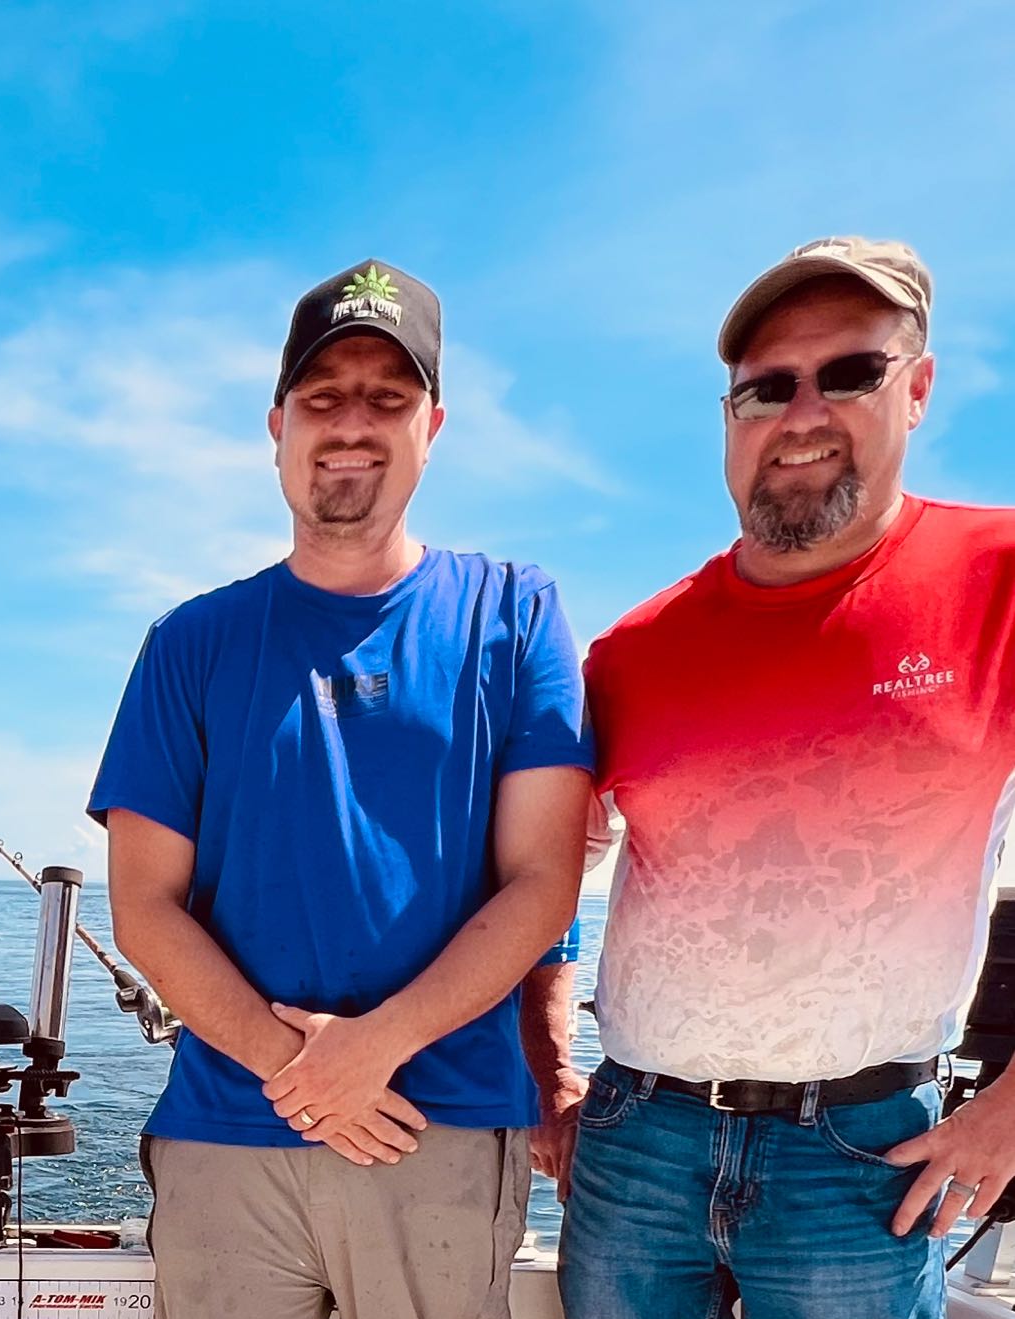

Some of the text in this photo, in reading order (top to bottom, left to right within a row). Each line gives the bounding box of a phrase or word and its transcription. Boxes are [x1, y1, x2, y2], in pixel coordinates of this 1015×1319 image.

[331, 295, 402, 326] NEW YORK
[872, 670, 955, 695] REALTREE
[31, 1294, 106, 1303] A-TOM-MIK
[113, 1297, 127, 1306] 19
[128, 1294, 151, 1309] 20
